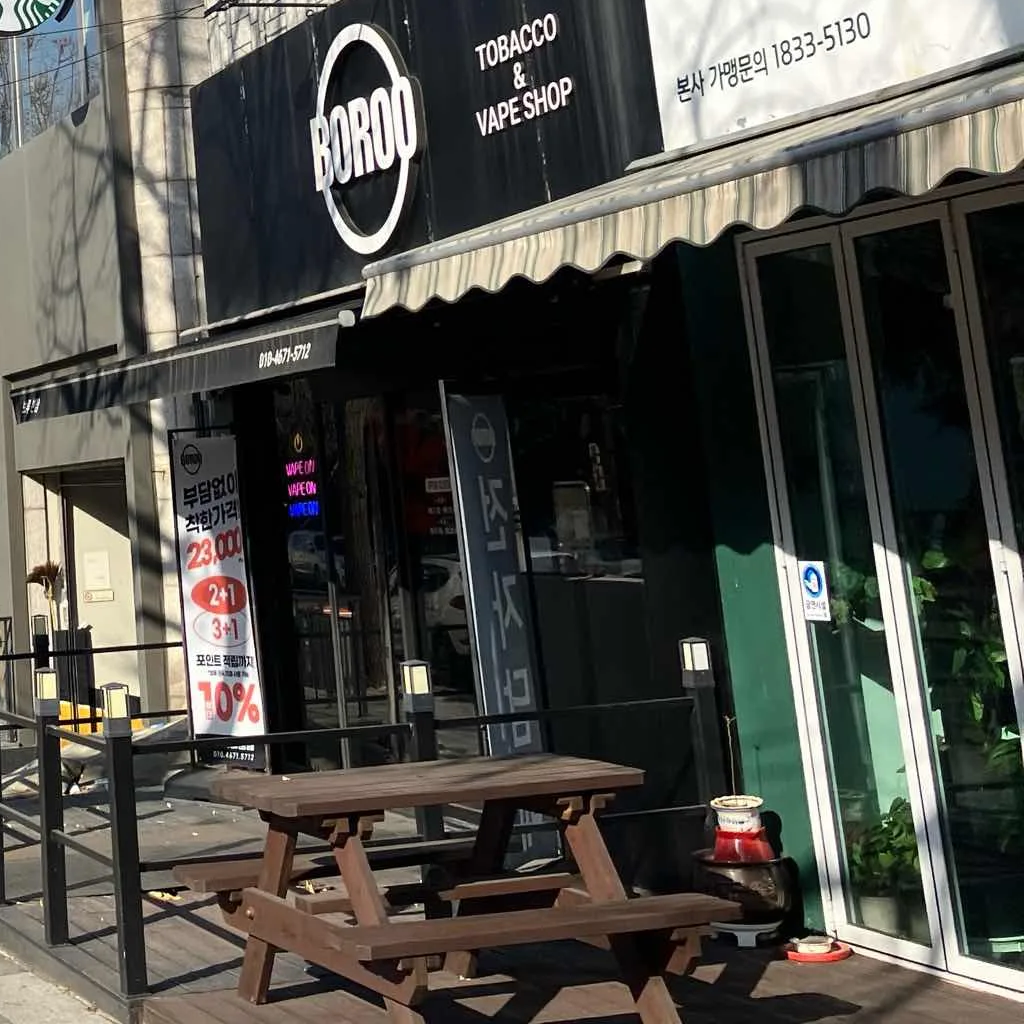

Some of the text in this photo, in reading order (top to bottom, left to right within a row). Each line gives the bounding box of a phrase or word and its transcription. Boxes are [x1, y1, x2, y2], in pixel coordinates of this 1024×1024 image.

[475, 13, 557, 71] TOBACCO
[676, 12, 871, 103] 본사 가맹문의 1833-5130
[513, 61, 527, 90] &
[476, 76, 573, 136] VAPE SHOP
[310, 76, 418, 192] BOROO
[286, 459, 315, 476] VAPE ON
[287, 480, 317, 497] VAPE ON
[186, 526, 243, 570] 23,000
[208, 583, 237, 606] 2+1
[212, 617, 239, 641] 3+1
[196, 654, 222, 667] 포인트
[197, 681, 261, 724] 10%
